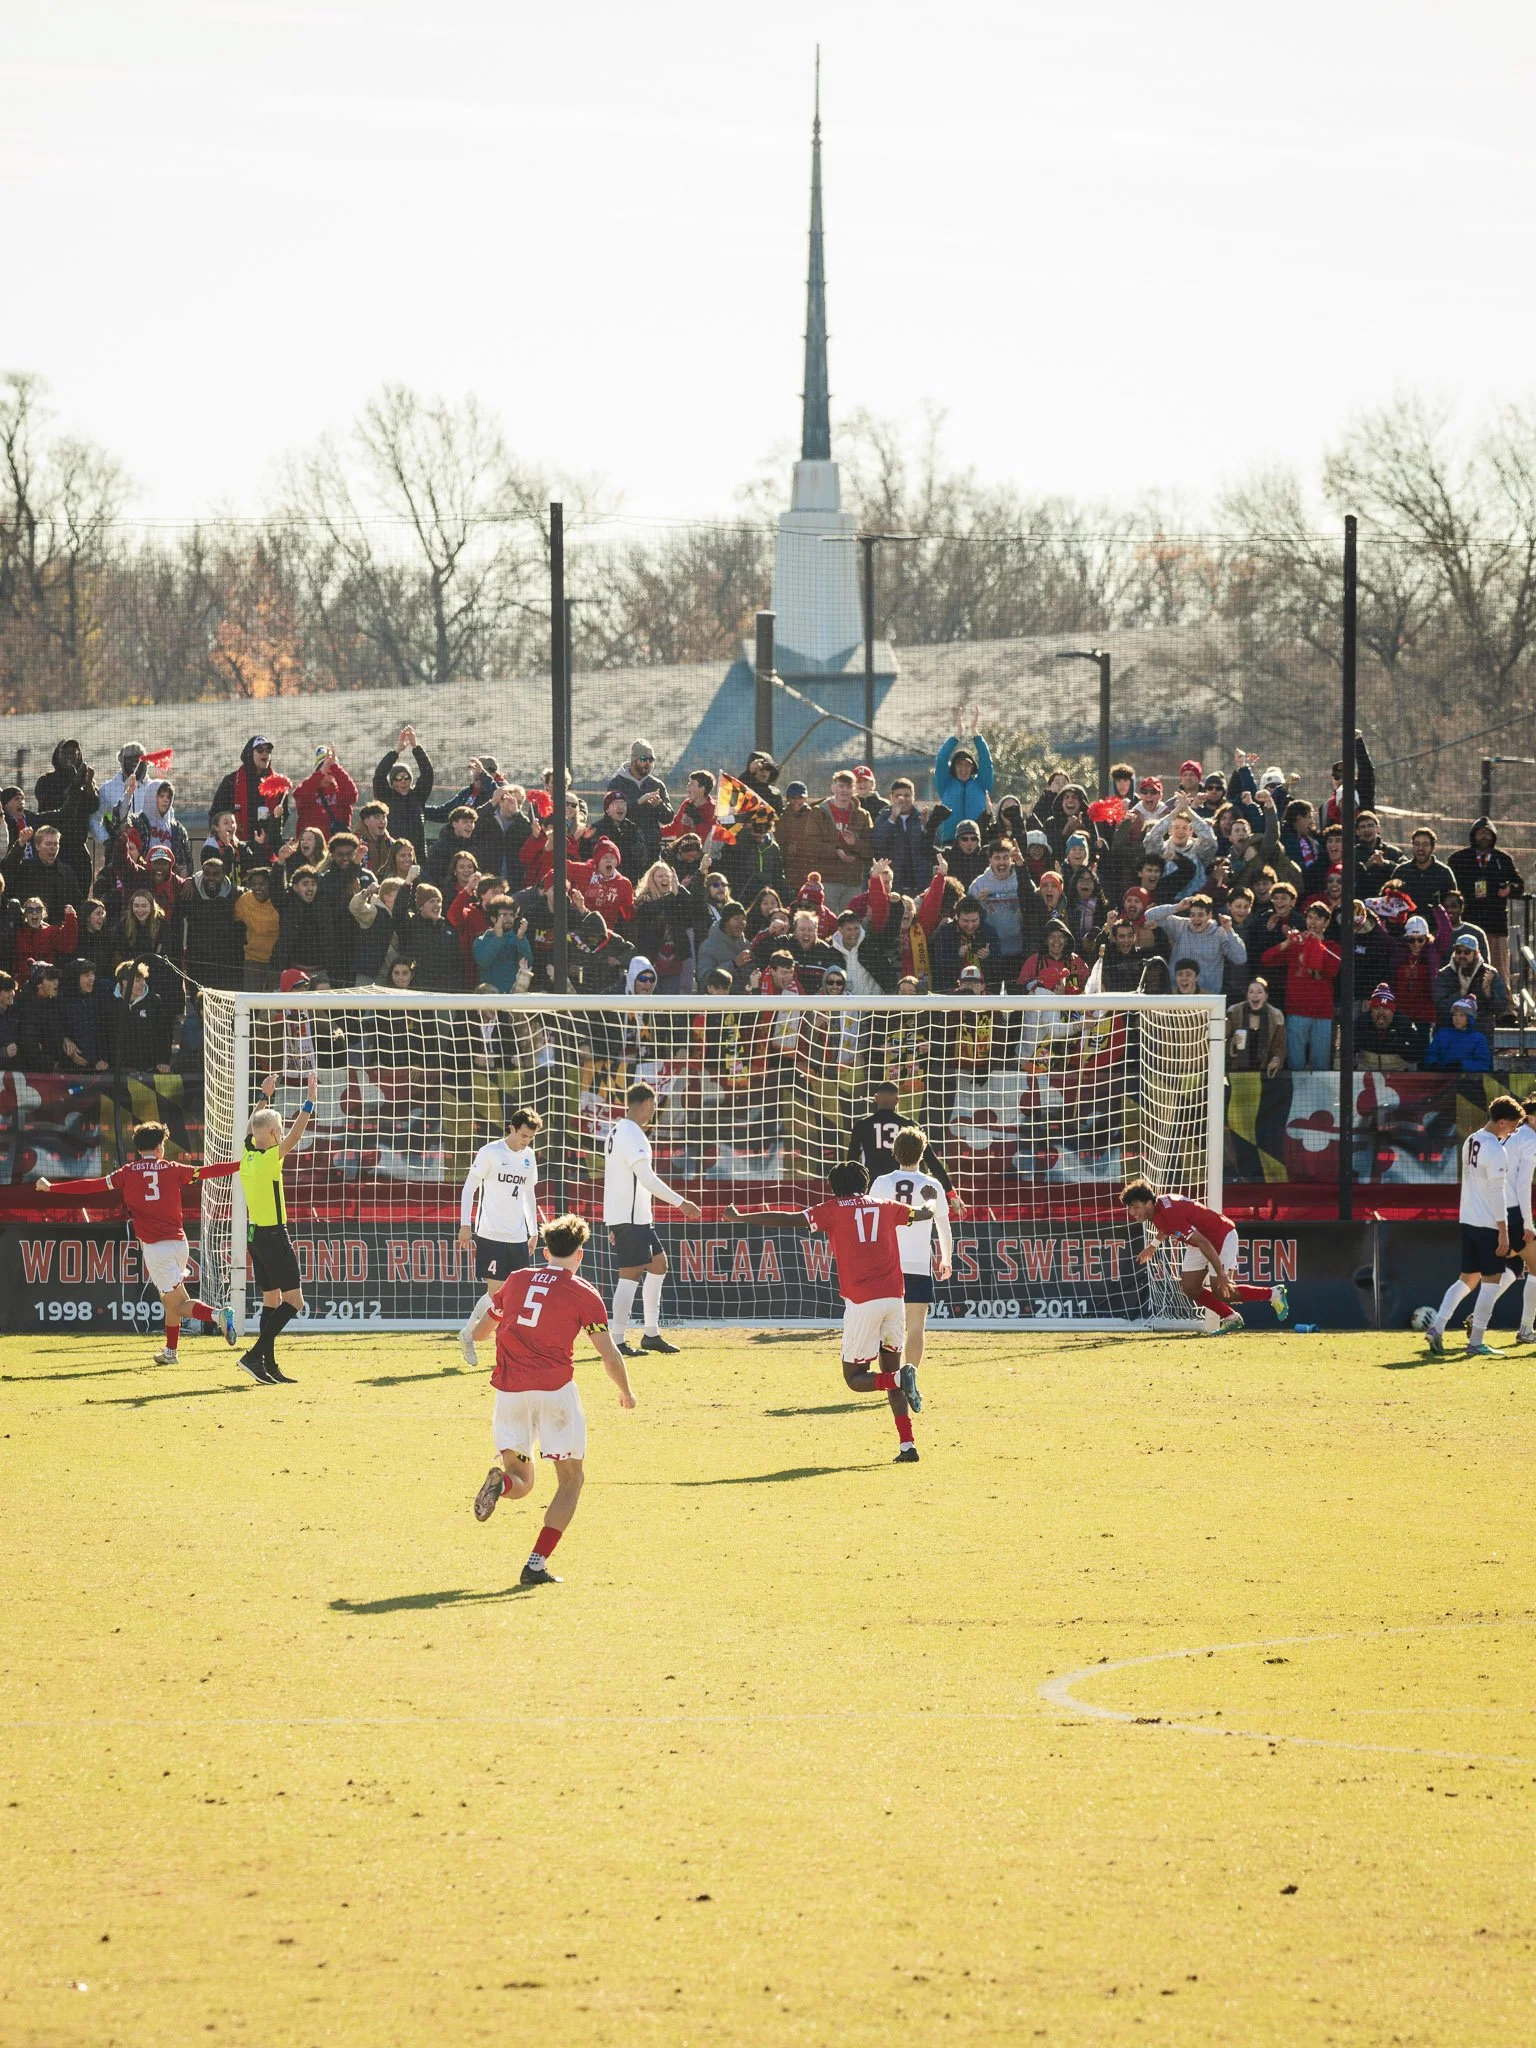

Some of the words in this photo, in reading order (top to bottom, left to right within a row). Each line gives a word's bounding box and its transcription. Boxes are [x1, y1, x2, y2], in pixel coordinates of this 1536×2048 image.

[873, 1122, 900, 1149] 13
[143, 1171, 160, 1201] 3
[512, 1185, 519, 1200] 4
[855, 1206, 880, 1243] 17
[488, 1260, 497, 1275] 4
[680, 1239, 781, 1282] NCAA
[996, 1239, 1125, 1282] SWEET
[531, 1272, 558, 1285] KELP
[35, 1301, 92, 1321] 1998
[107, 1301, 164, 1321] 1999
[325, 1300, 382, 1320] 2012
[516, 1284, 550, 1328] 5
[964, 1300, 1020, 1318] 2009
[1034, 1300, 1088, 1318] 2011
